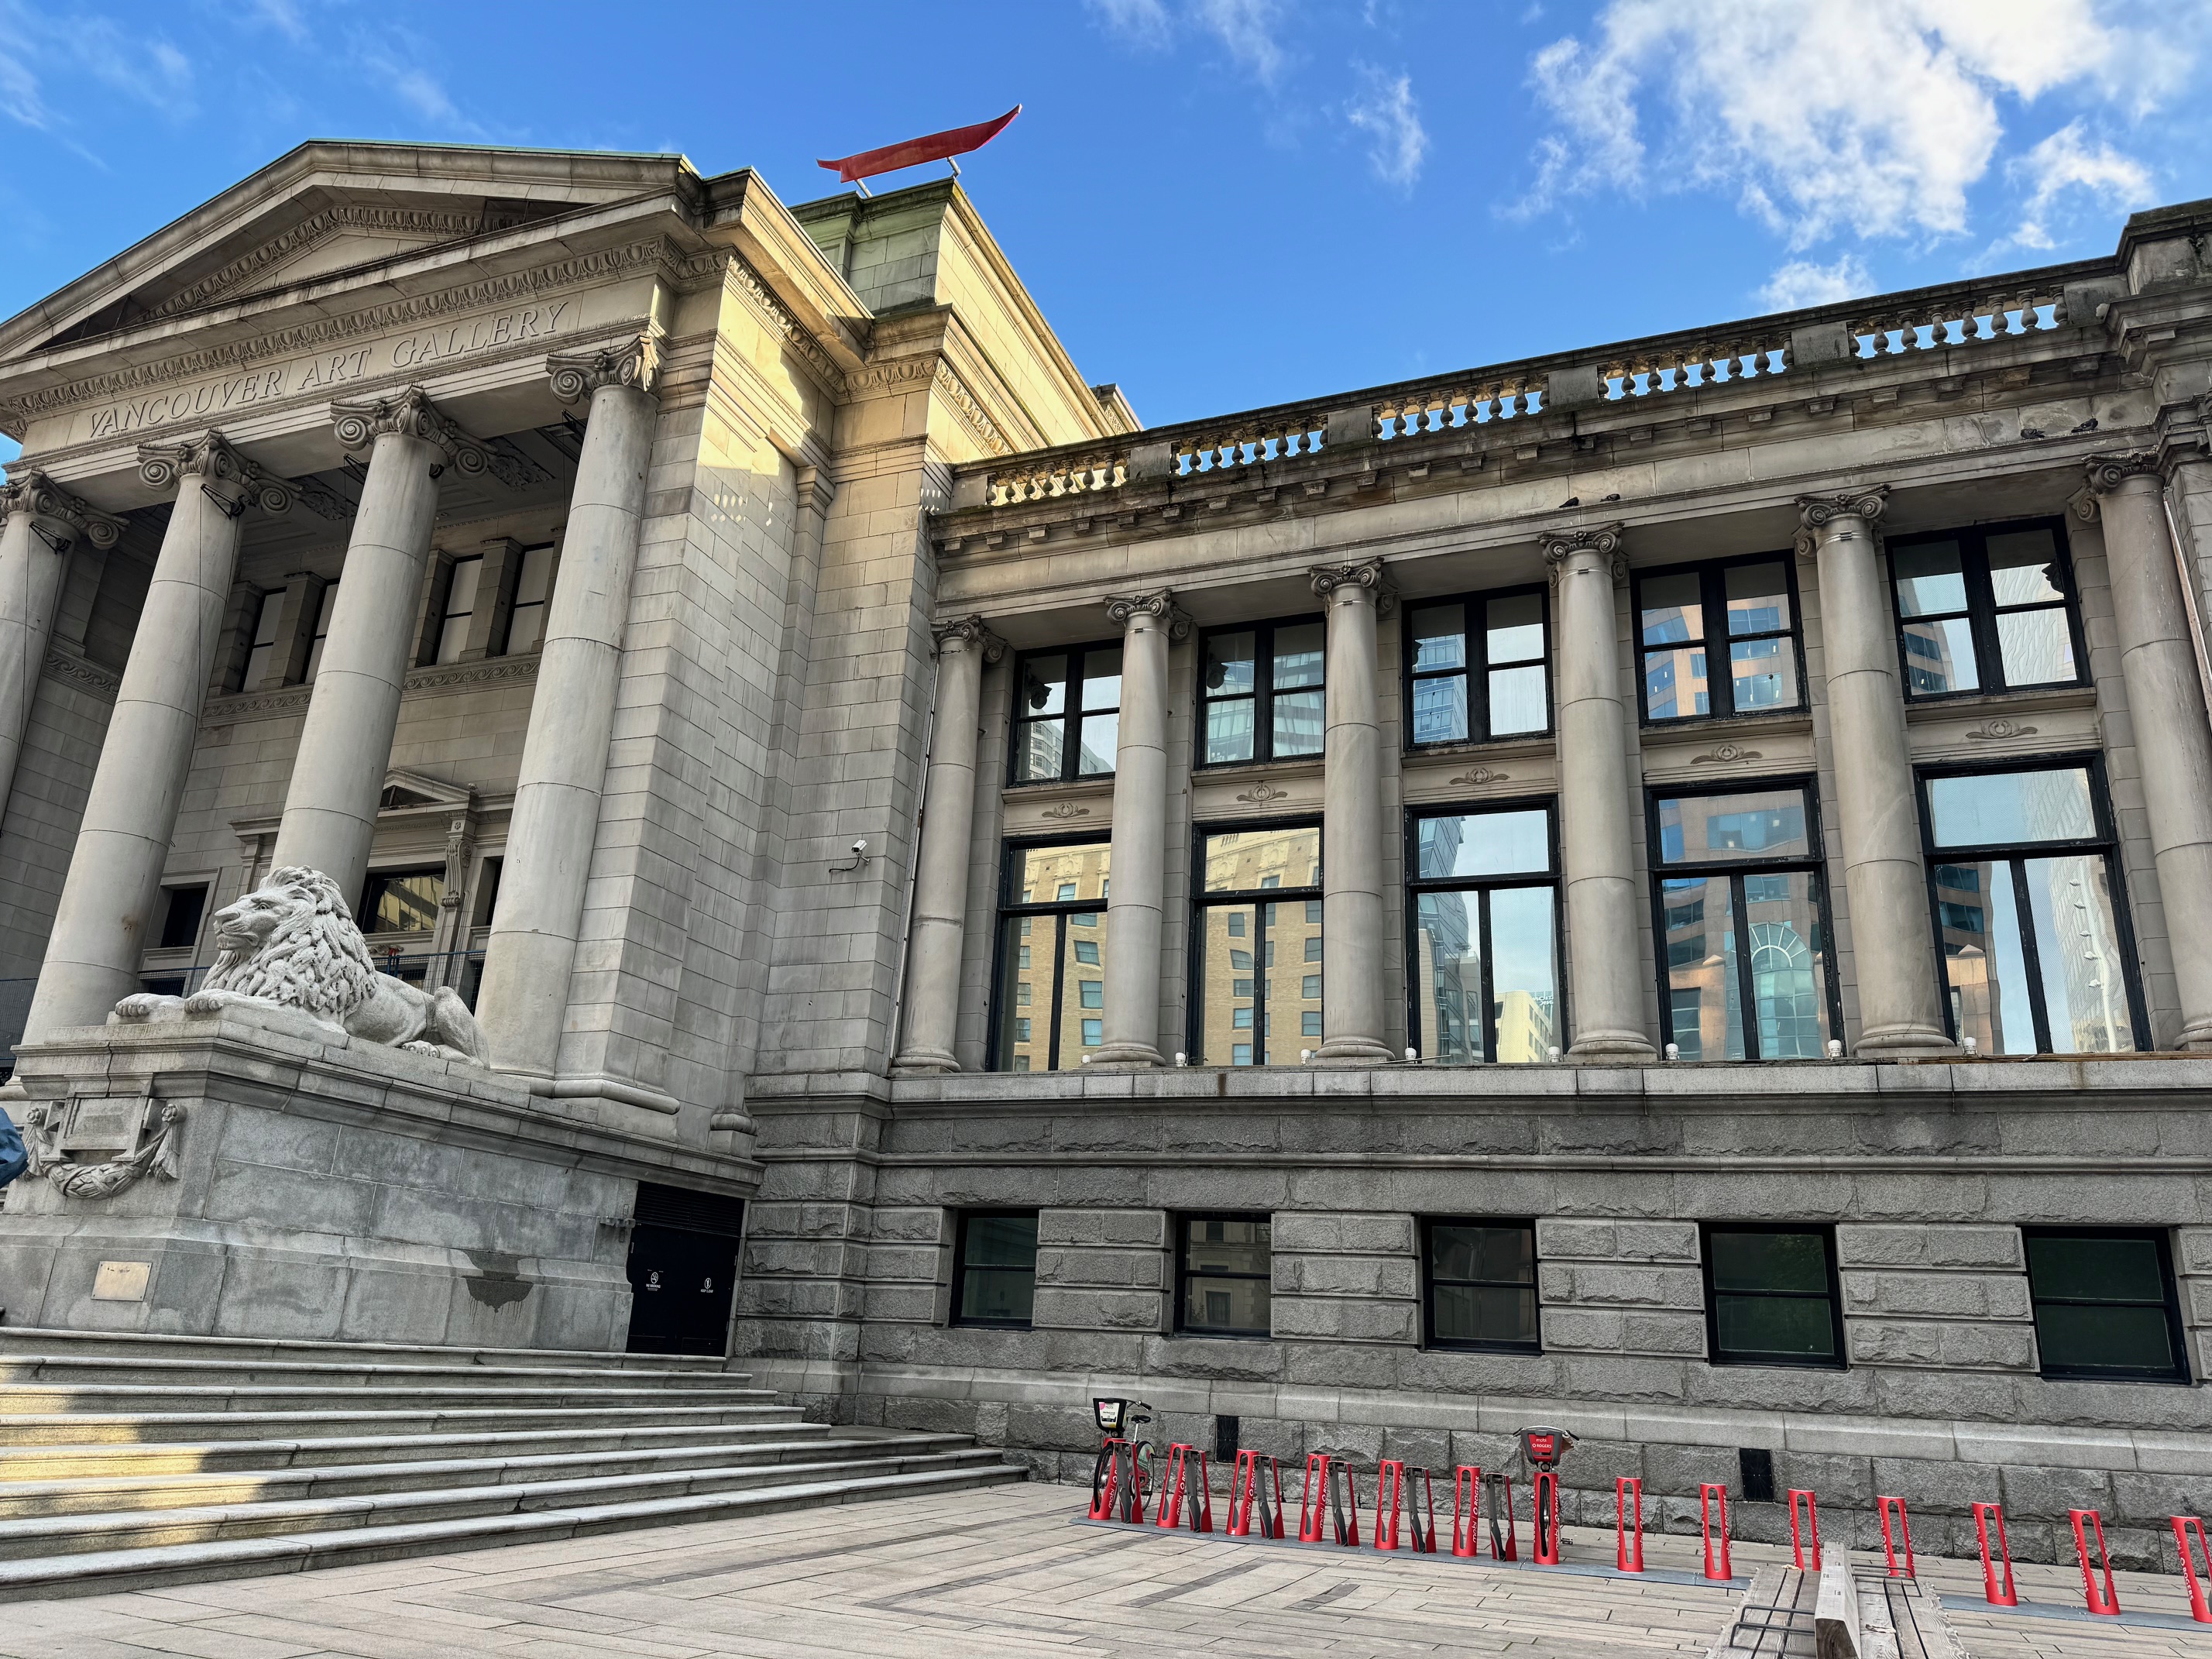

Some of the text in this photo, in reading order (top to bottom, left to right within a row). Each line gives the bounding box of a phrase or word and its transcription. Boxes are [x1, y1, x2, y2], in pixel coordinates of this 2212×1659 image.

[90, 301, 568, 438] VANCOUVER ART GALLERY
[2079, 1559, 2088, 1592] ROGERS
[2183, 1568, 2194, 1601] ROGERS
